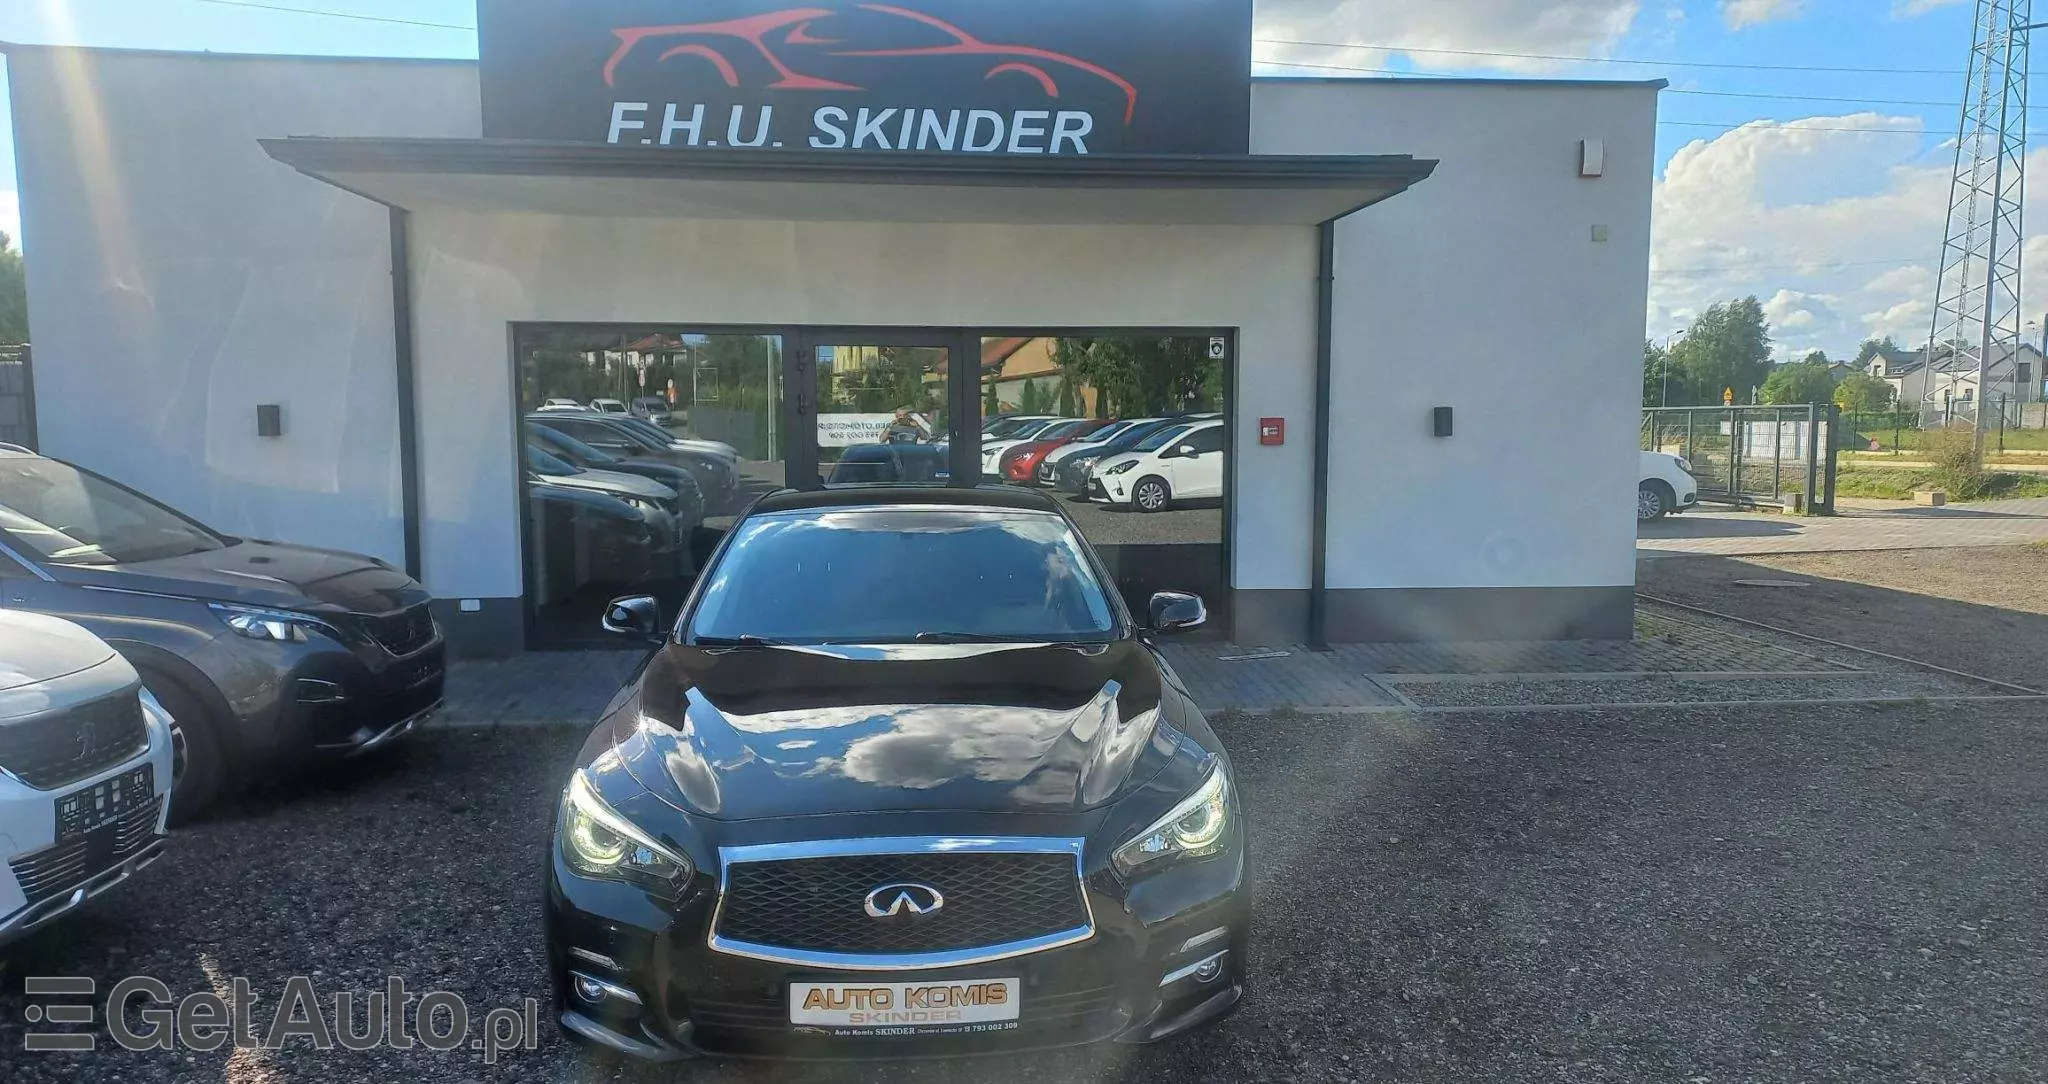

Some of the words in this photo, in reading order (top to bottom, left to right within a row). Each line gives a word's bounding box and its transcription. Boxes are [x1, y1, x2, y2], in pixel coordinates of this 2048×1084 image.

[607, 101, 783, 148] F.H.U.
[808, 105, 1095, 154] SKINDER
[803, 988, 894, 1010] AUTO
[905, 983, 1008, 1009] KOMIS
[850, 1010, 963, 1024] SKINDER
[834, 1028, 851, 1036] Auto
[852, 1028, 874, 1036] Komis
[875, 1026, 916, 1036] SKINDER
[972, 1023, 987, 1032] 793
[988, 1022, 1002, 1031] 002
